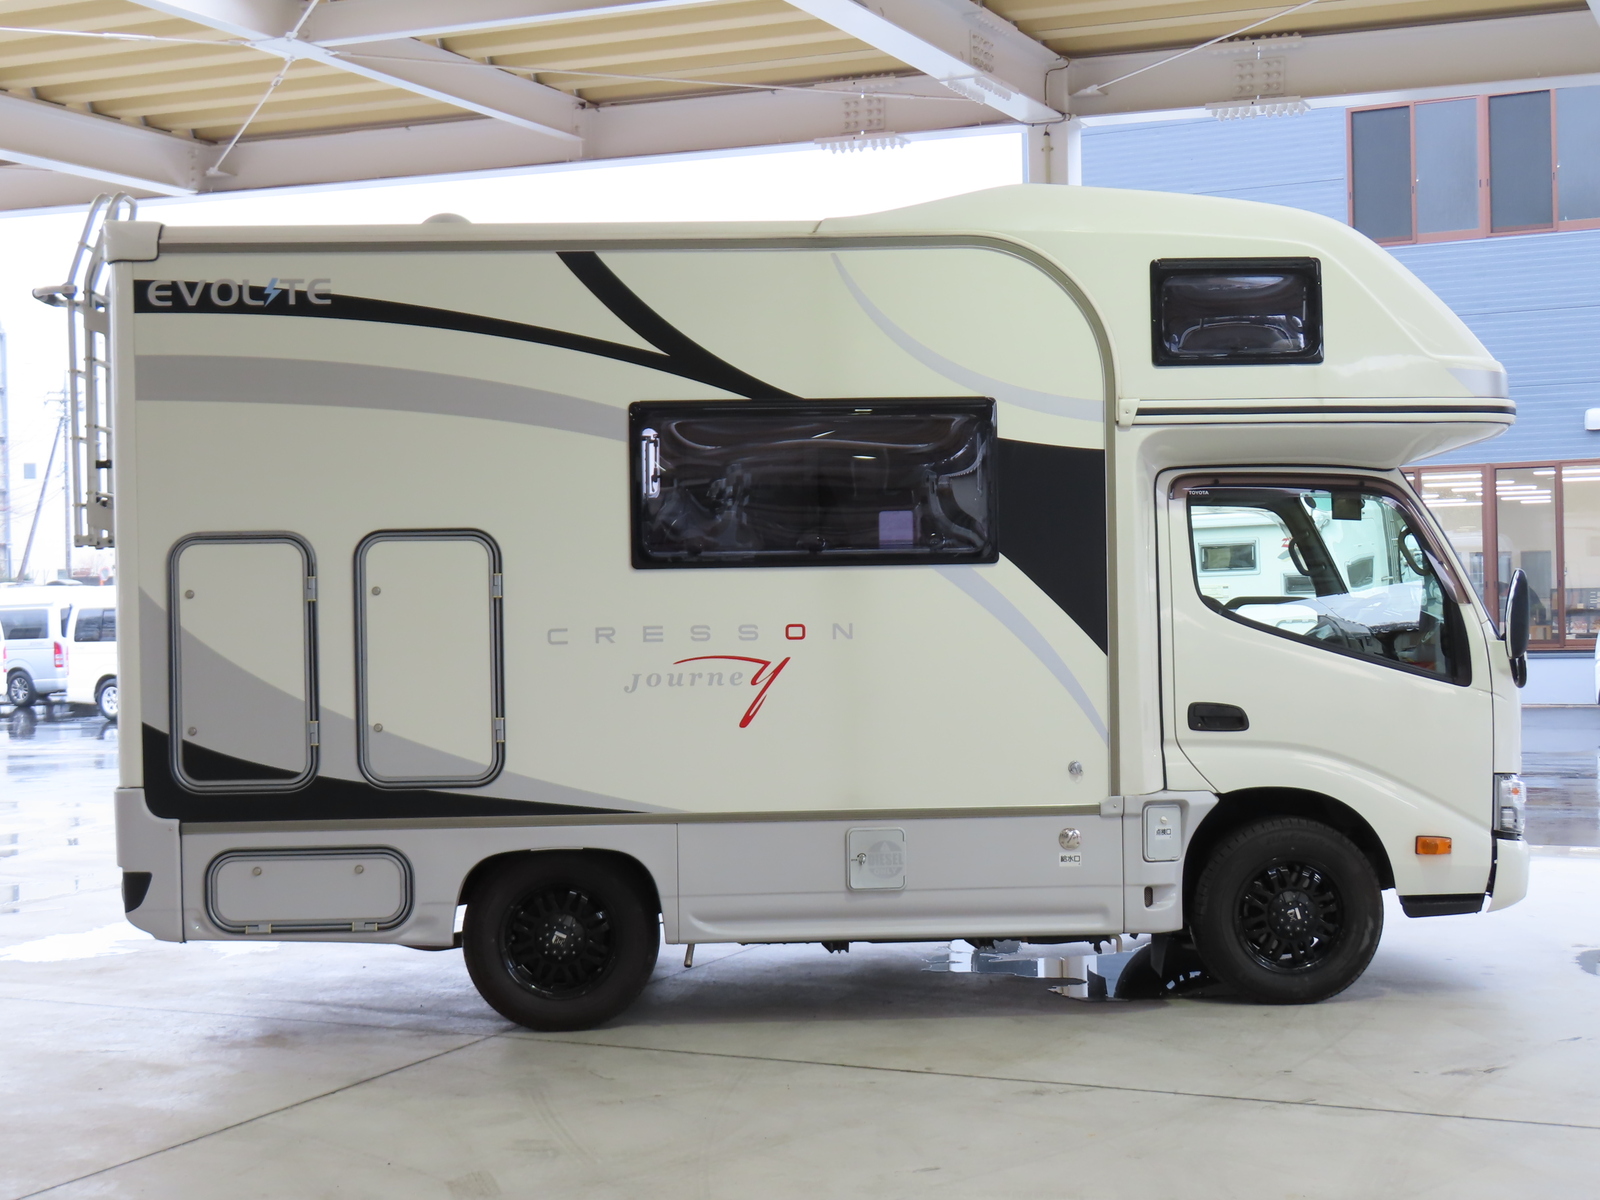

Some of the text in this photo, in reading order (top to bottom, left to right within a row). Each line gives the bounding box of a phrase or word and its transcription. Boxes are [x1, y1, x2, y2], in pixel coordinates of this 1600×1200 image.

[547, 622, 854, 646] CRESSON
[867, 853, 904, 866] DIESEL
[1060, 855, 1081, 863] 給水口
[873, 867, 898, 876] ONLY
